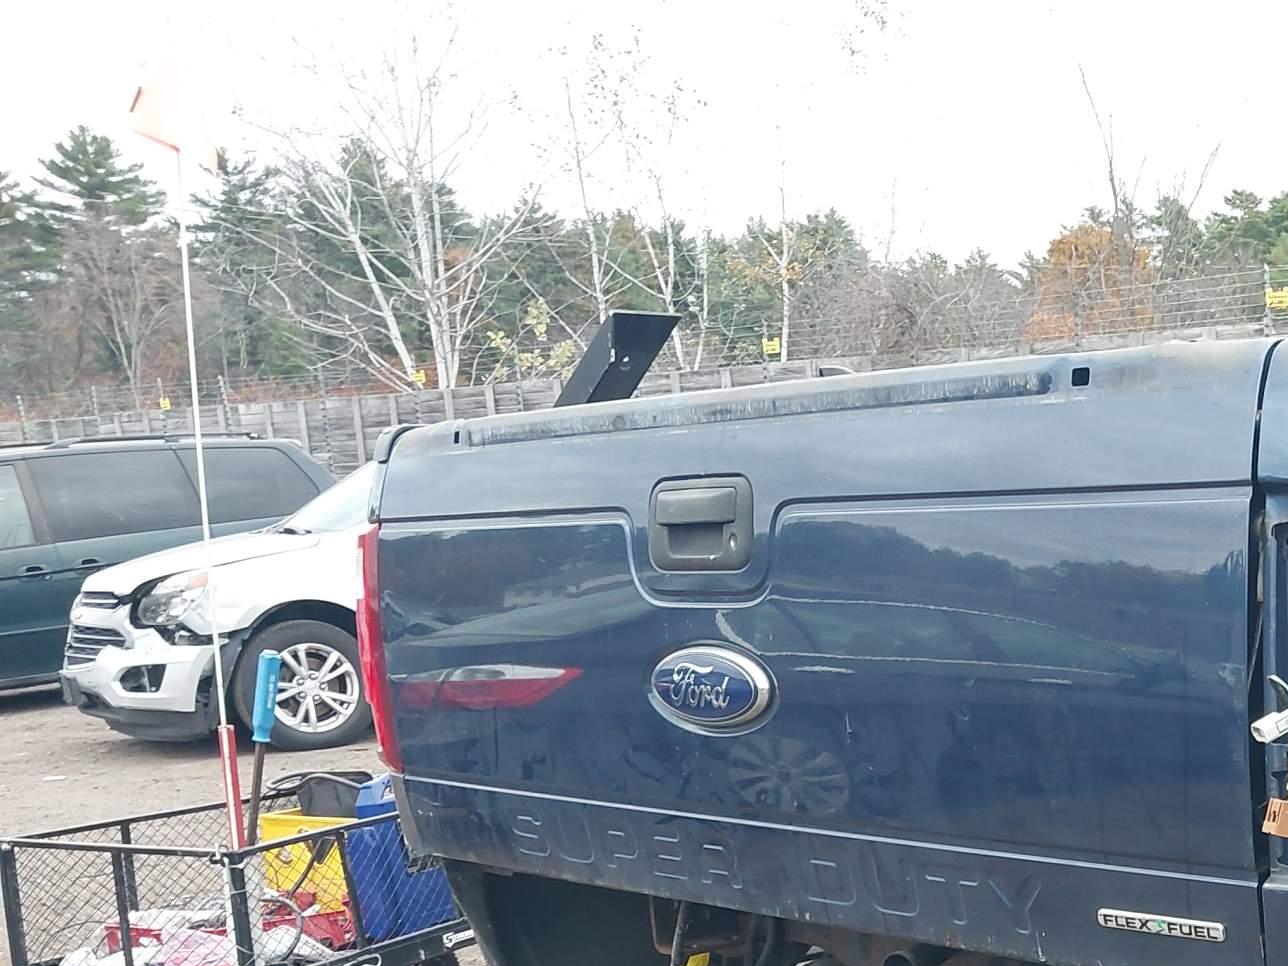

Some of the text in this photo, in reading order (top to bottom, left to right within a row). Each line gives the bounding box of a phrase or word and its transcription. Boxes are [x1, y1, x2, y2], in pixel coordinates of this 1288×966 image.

[670, 662, 730, 709] Ford
[511, 807, 1043, 935] SUPER DUTY
[1102, 914, 1219, 940] FLEX FUEL
